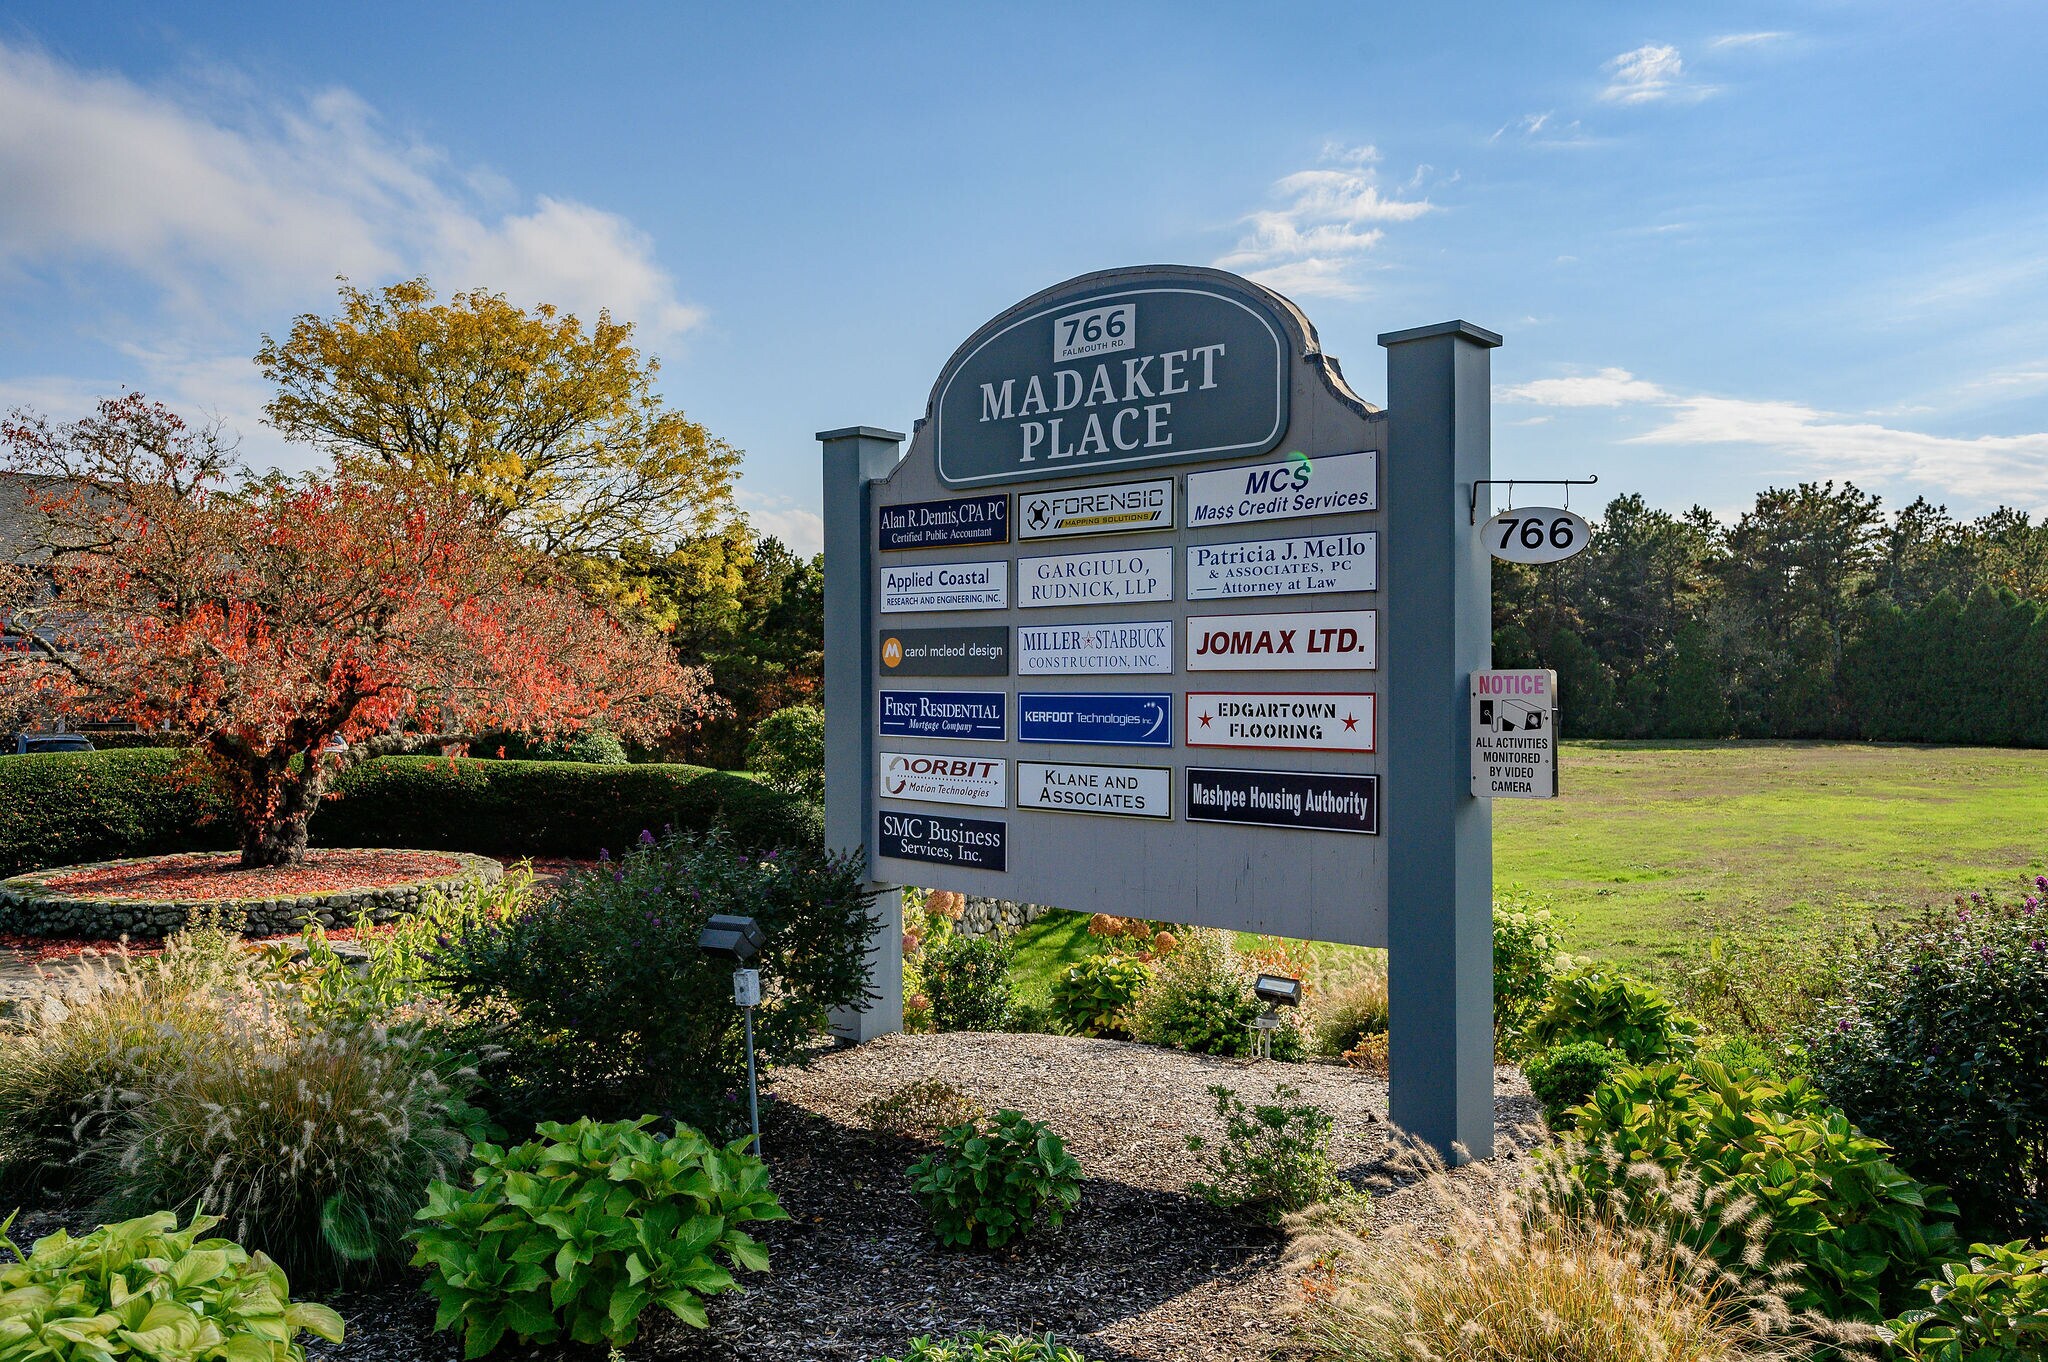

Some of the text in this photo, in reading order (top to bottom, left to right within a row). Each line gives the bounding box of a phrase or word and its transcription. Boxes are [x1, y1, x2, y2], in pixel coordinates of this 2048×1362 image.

[1063, 310, 1125, 346] 766
[1063, 342, 1107, 357] FALMOUTH
[979, 343, 1225, 422] MADAKET
[1019, 403, 1173, 463] PLACE
[1052, 489, 1163, 515] FORENSIC
[1238, 497, 1288, 516] Credit
[1293, 491, 1368, 510] Services
[881, 511, 905, 529] Alan
[908, 509, 919, 527] R.
[988, 501, 1005, 520] PC
[1065, 514, 1149, 526] MAPPING SOLUTIONS
[892, 528, 992, 543] Certified Public Accountant
[1498, 518, 1574, 549] 766
[1197, 537, 1365, 566] Patricia J. Mello
[1038, 557, 1149, 579] GARGIULO,
[1209, 561, 1352, 578] & ASSOCIATES, PC
[887, 568, 989, 592] Applied Coastal
[1032, 578, 1157, 600] RUDNICK, LLP
[1222, 577, 1336, 594] Attorney at Law
[887, 594, 1000, 605] RESEARCH AND ENGINEERING, INC.
[1024, 628, 1165, 650] MILLER STARBUCK
[1197, 629, 1365, 654] JOMAX LTD.
[905, 643, 1002, 659] carol mcleod design
[1029, 655, 1159, 668] CONSTRUCTION, INC.
[1479, 675, 1544, 695] NOTICE
[885, 697, 1000, 718] FIRST RESIDENTIAL
[1218, 702, 1336, 718] EDGARTOWN
[909, 719, 972, 732] Mortgage Company
[1025, 711, 1074, 722] KERFOOT
[1077, 713, 1140, 726] Technologies
[1230, 723, 1322, 740] FLOORING
[1476, 738, 1548, 749] ALL ACTIVITIES
[1484, 752, 1540, 764] MONITORED
[911, 759, 999, 778] ORBIT
[1490, 767, 1534, 778] BY VIDEO
[1045, 769, 1138, 789] KLANE AND
[1492, 781, 1532, 792] CAMERA
[909, 782, 990, 799] Motion Technologies
[1039, 787, 1145, 809] ASSOCIATES
[1193, 783, 1367, 821] Mashpee Housing Authority
[884, 816, 1000, 847] SMC Business
[901, 839, 982, 862] Services, Inc.
